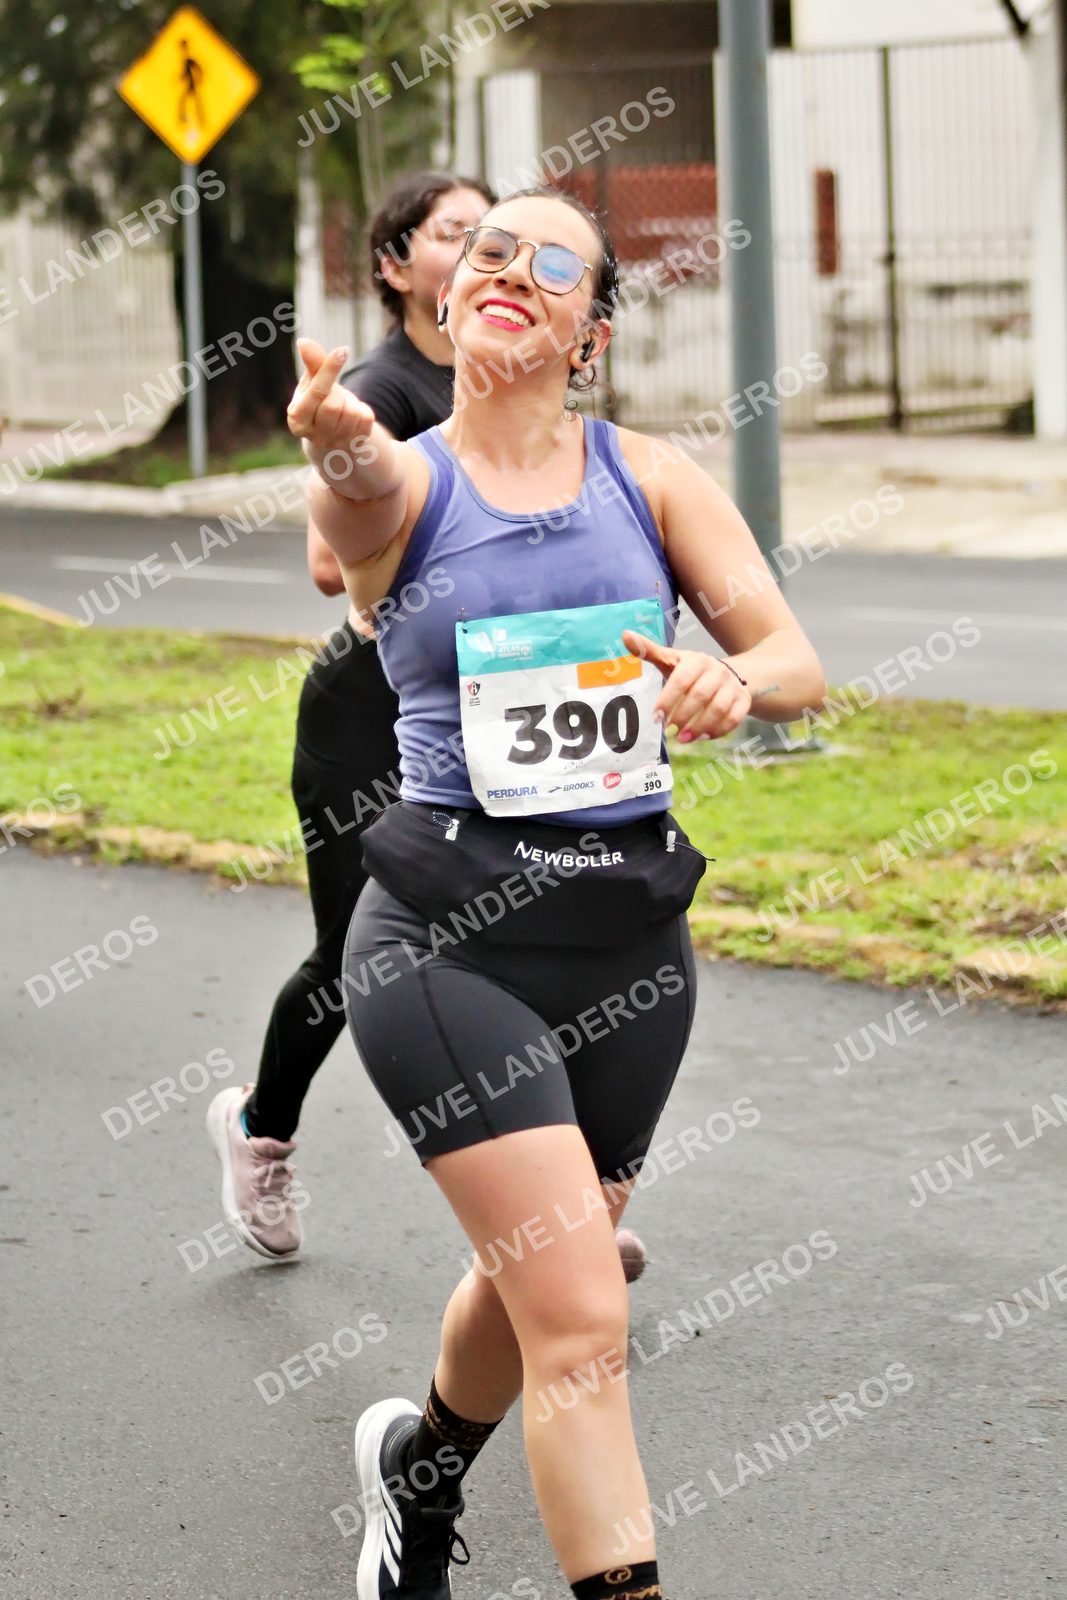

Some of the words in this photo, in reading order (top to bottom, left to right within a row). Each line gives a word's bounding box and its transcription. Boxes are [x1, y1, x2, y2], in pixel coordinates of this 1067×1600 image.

[504, 694, 640, 766] 390
[645, 771, 658, 779] RIFA
[563, 781, 595, 792] BROOKS
[644, 780, 662, 792] 390
[487, 786, 538, 799] PERDURA
[513, 841, 625, 868] NEWBOLER
